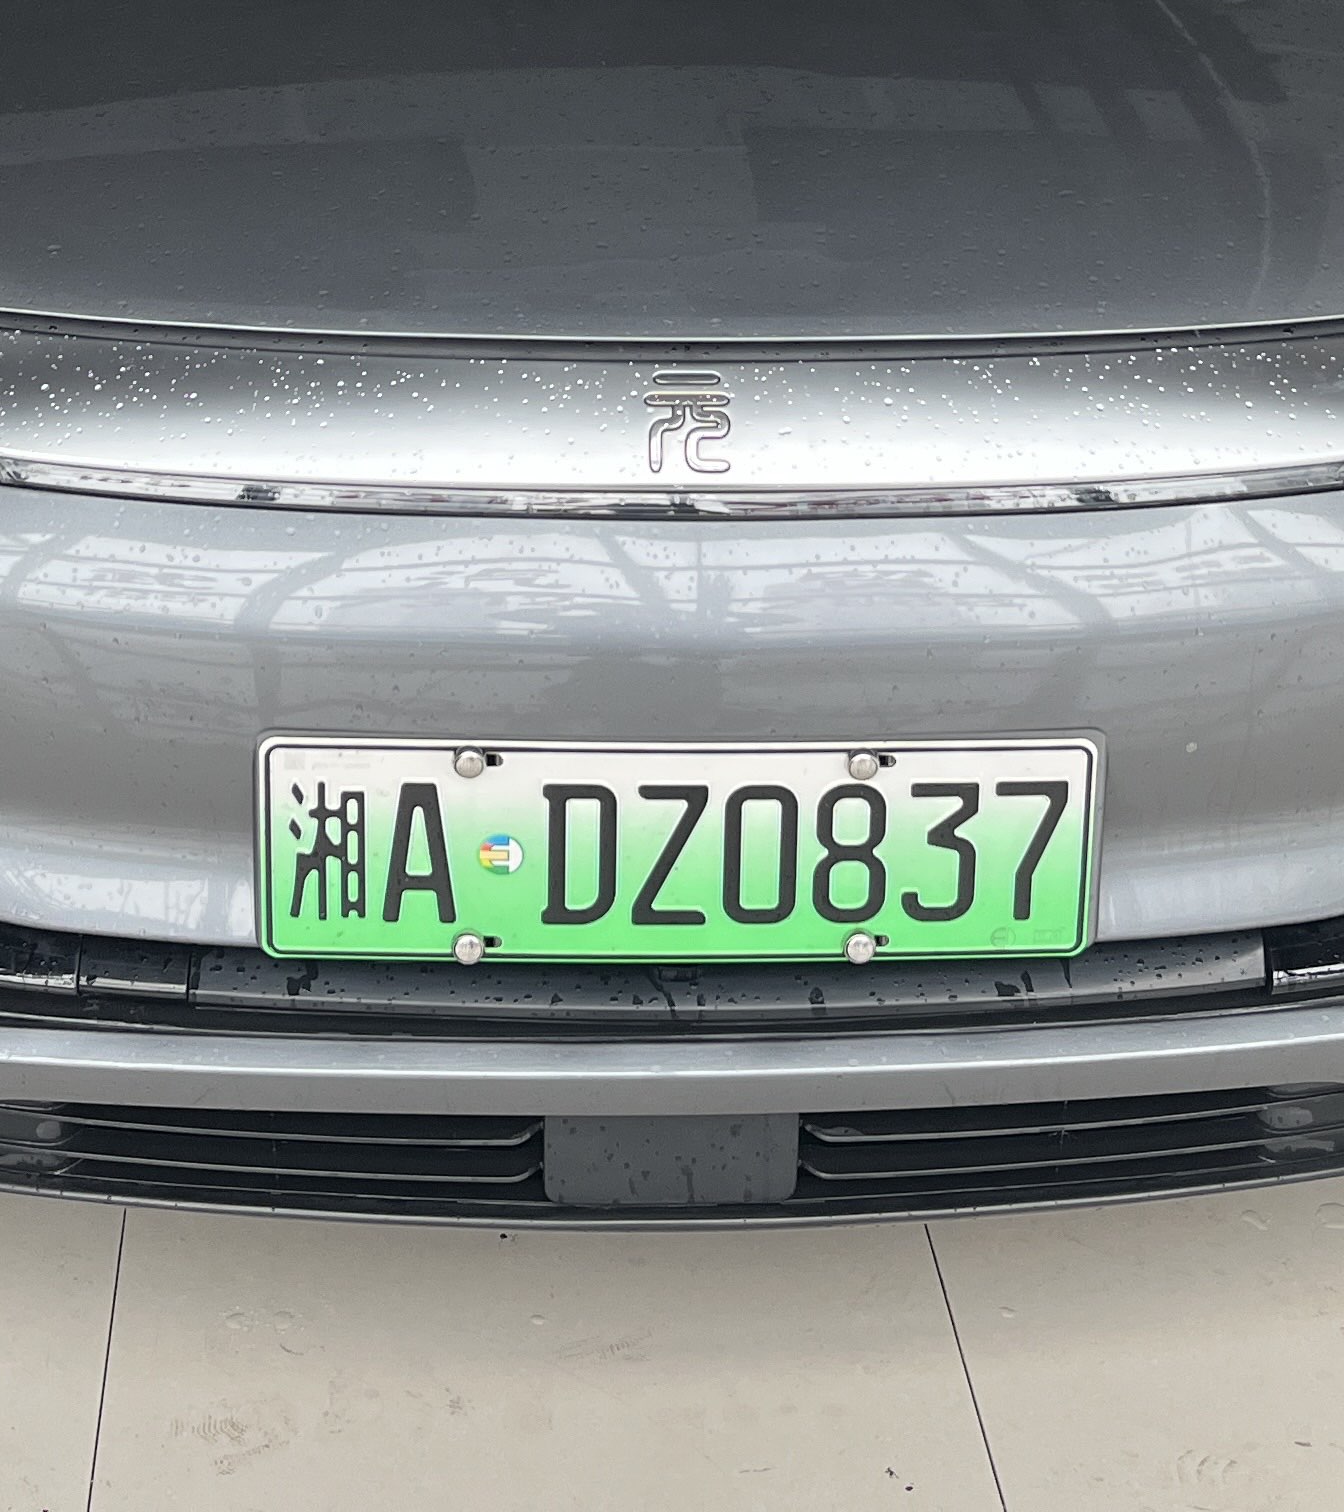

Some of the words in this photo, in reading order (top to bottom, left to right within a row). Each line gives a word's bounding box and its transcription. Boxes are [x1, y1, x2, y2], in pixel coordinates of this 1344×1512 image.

[643, 370, 731, 473] 元
[289, 780, 457, 924] 湘A
[540, 781, 1071, 927] DZ0837
